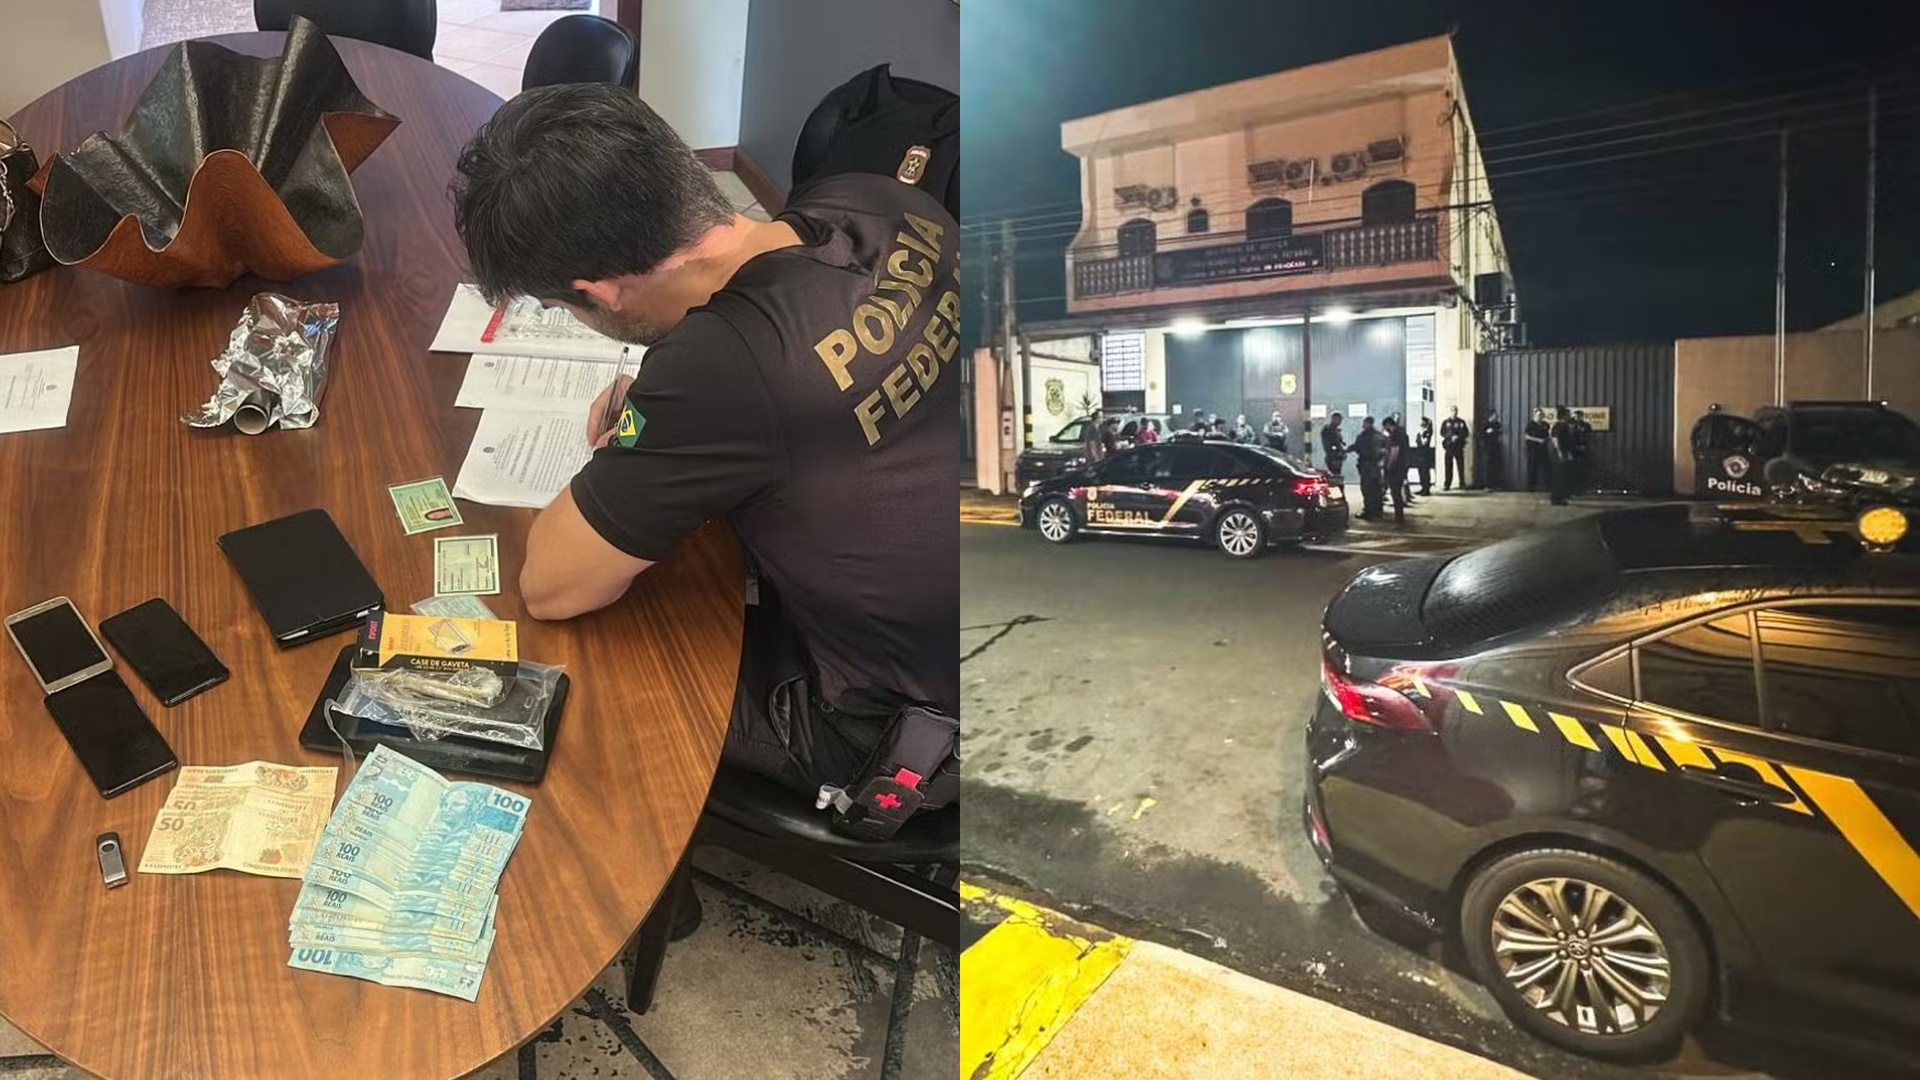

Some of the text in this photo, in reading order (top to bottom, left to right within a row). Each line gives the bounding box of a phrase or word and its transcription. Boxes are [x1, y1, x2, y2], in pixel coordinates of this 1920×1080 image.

[1087, 510, 1149, 523] FEDERAL
[410, 658, 470, 668] CASE DE GAVETA
[373, 792, 393, 807] 100
[493, 793, 525, 813] 100
[362, 810, 380, 821] REAIS
[157, 817, 185, 831] 50
[355, 825, 373, 837] REAIS
[339, 842, 360, 857] 100
[336, 852, 355, 862] REAIS
[326, 890, 347, 903] 100
[323, 901, 342, 909] REAIS
[316, 933, 336, 942] REAIS
